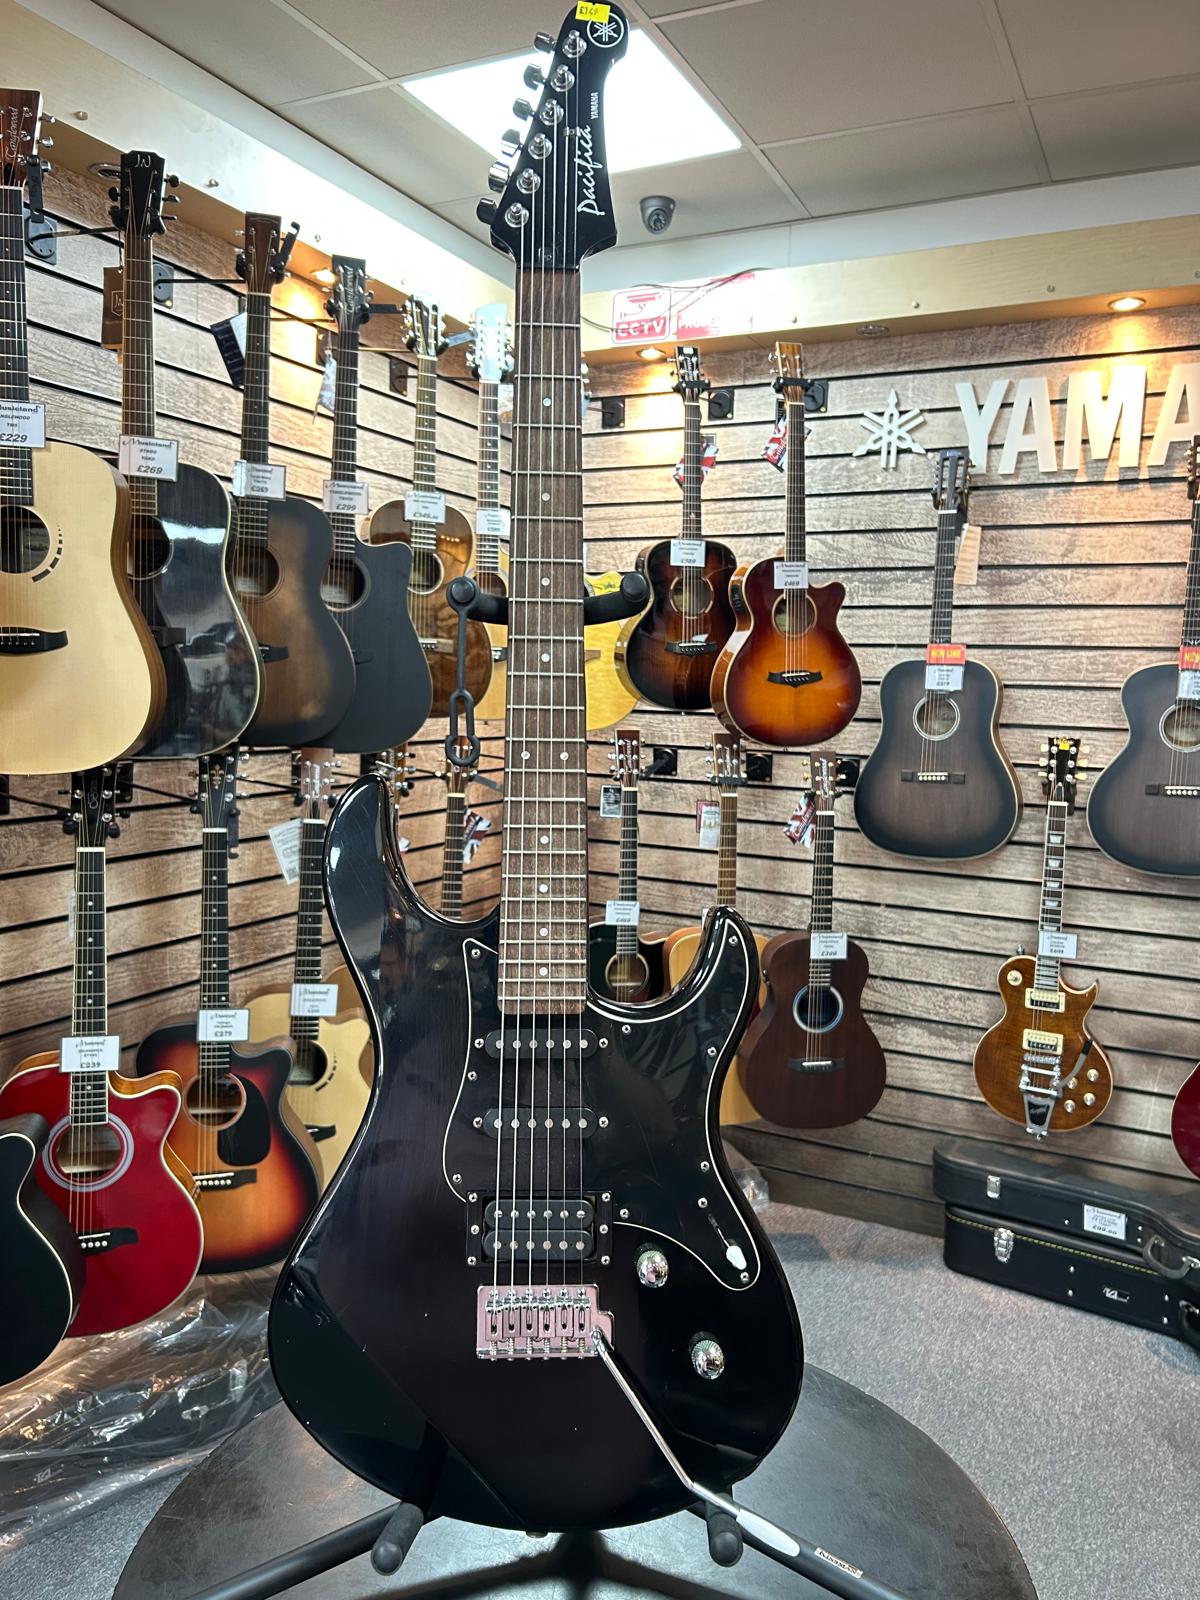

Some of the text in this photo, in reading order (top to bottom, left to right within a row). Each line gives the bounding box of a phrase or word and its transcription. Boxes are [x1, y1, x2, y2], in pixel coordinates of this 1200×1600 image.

[590, 92, 599, 119] YAMAHA
[574, 125, 605, 216] Pacifica
[616, 318, 666, 338] CCTV
[0, 432, 28, 443] £229
[137, 465, 163, 475] £269
